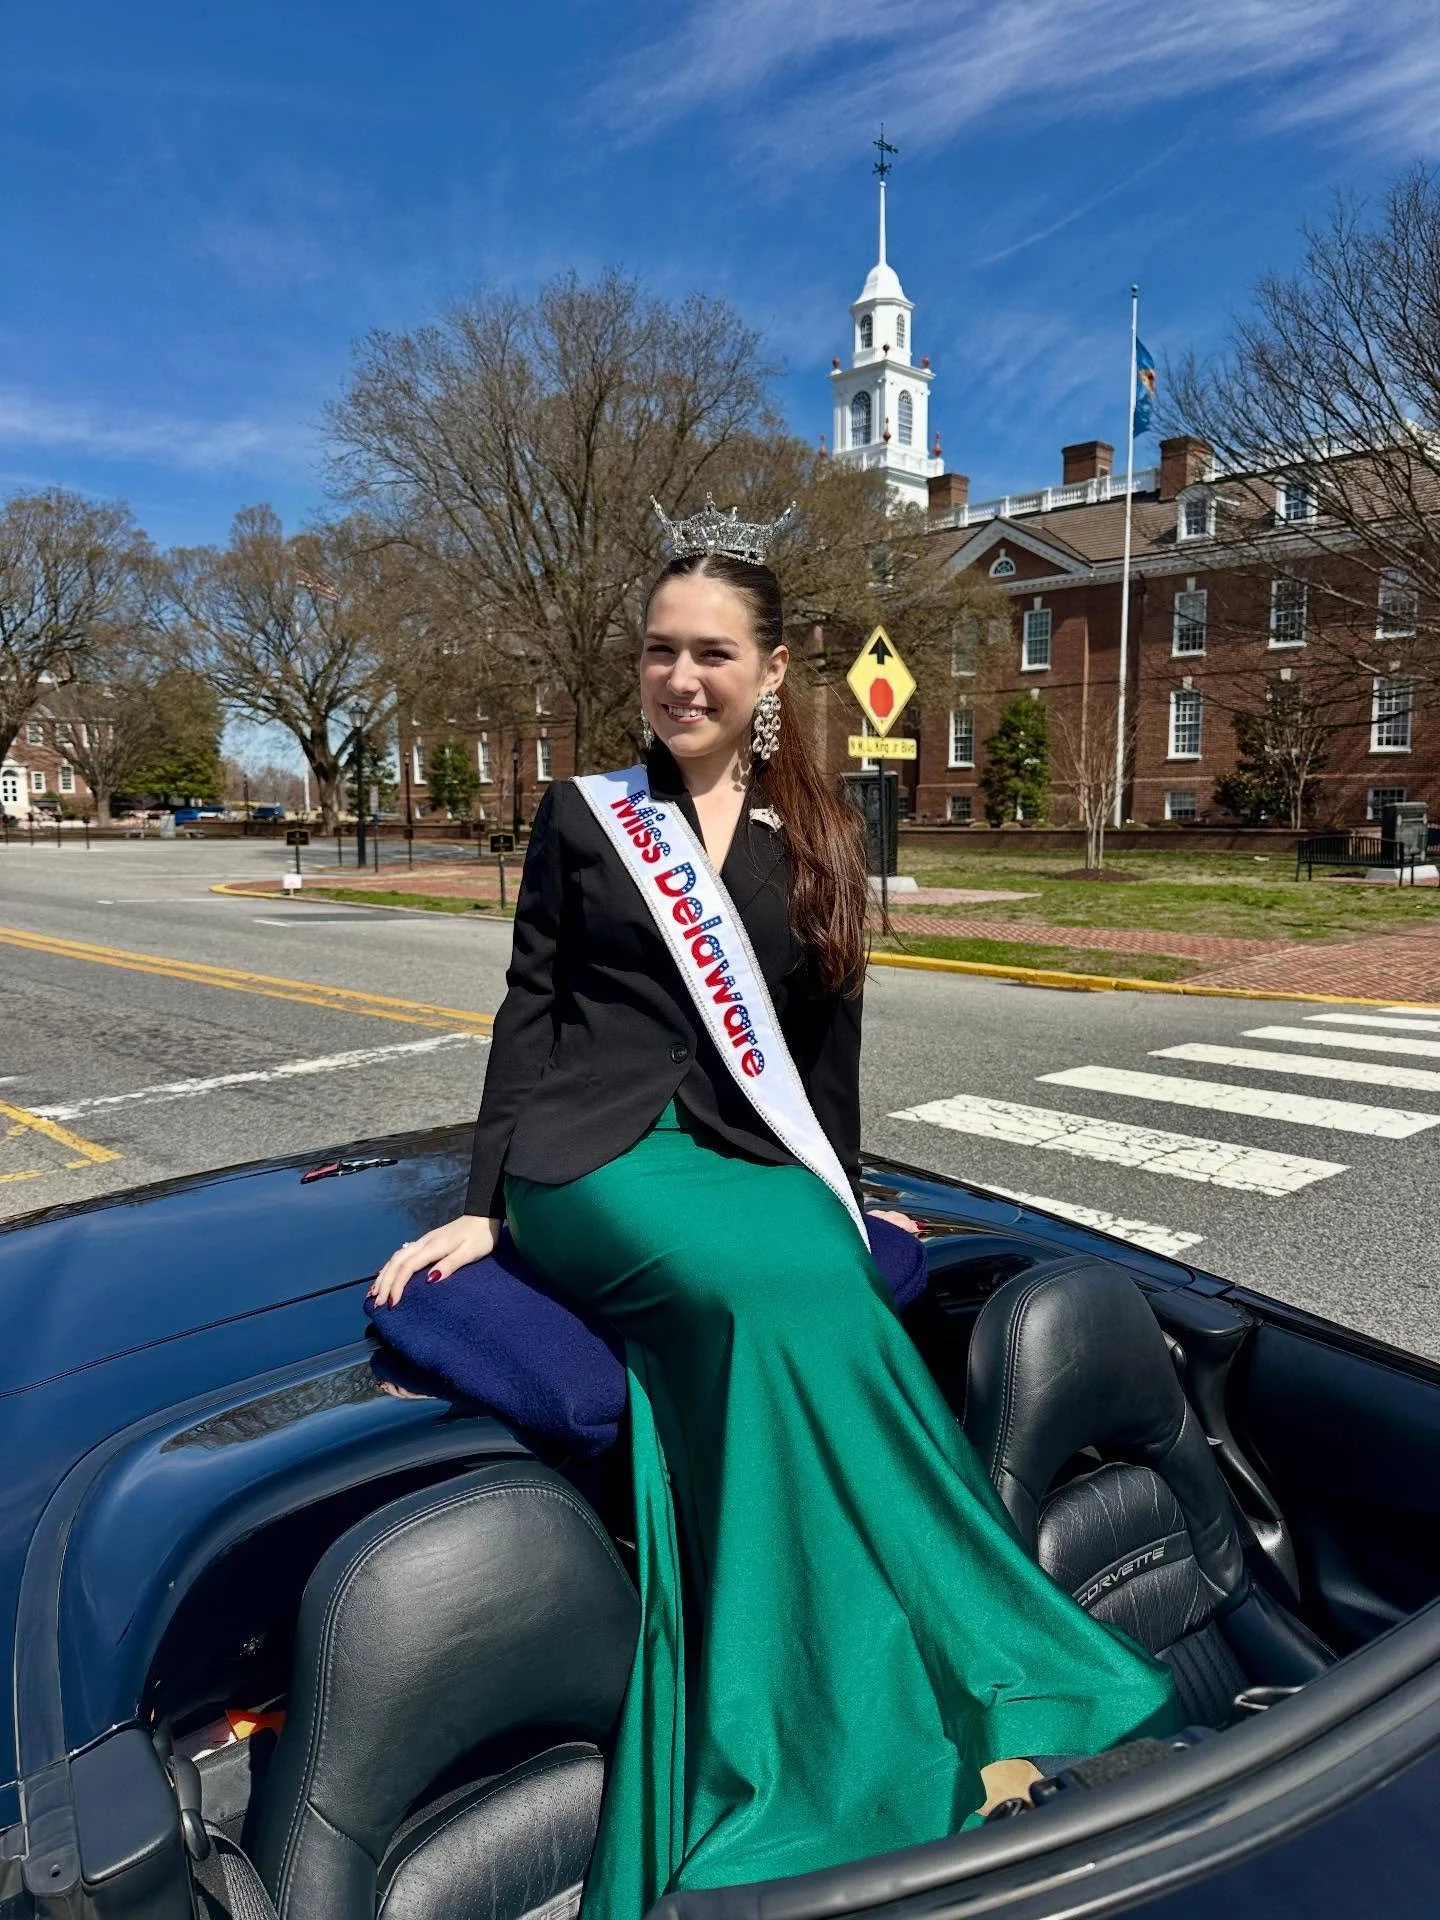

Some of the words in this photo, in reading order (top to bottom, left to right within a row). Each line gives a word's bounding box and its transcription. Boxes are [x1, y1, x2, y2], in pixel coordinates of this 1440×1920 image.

[875, 742, 888, 754] King
[610, 789, 671, 863] Miss
[654, 861, 765, 1077] Delaware
[1077, 1547, 1165, 1606] CORVETTE
